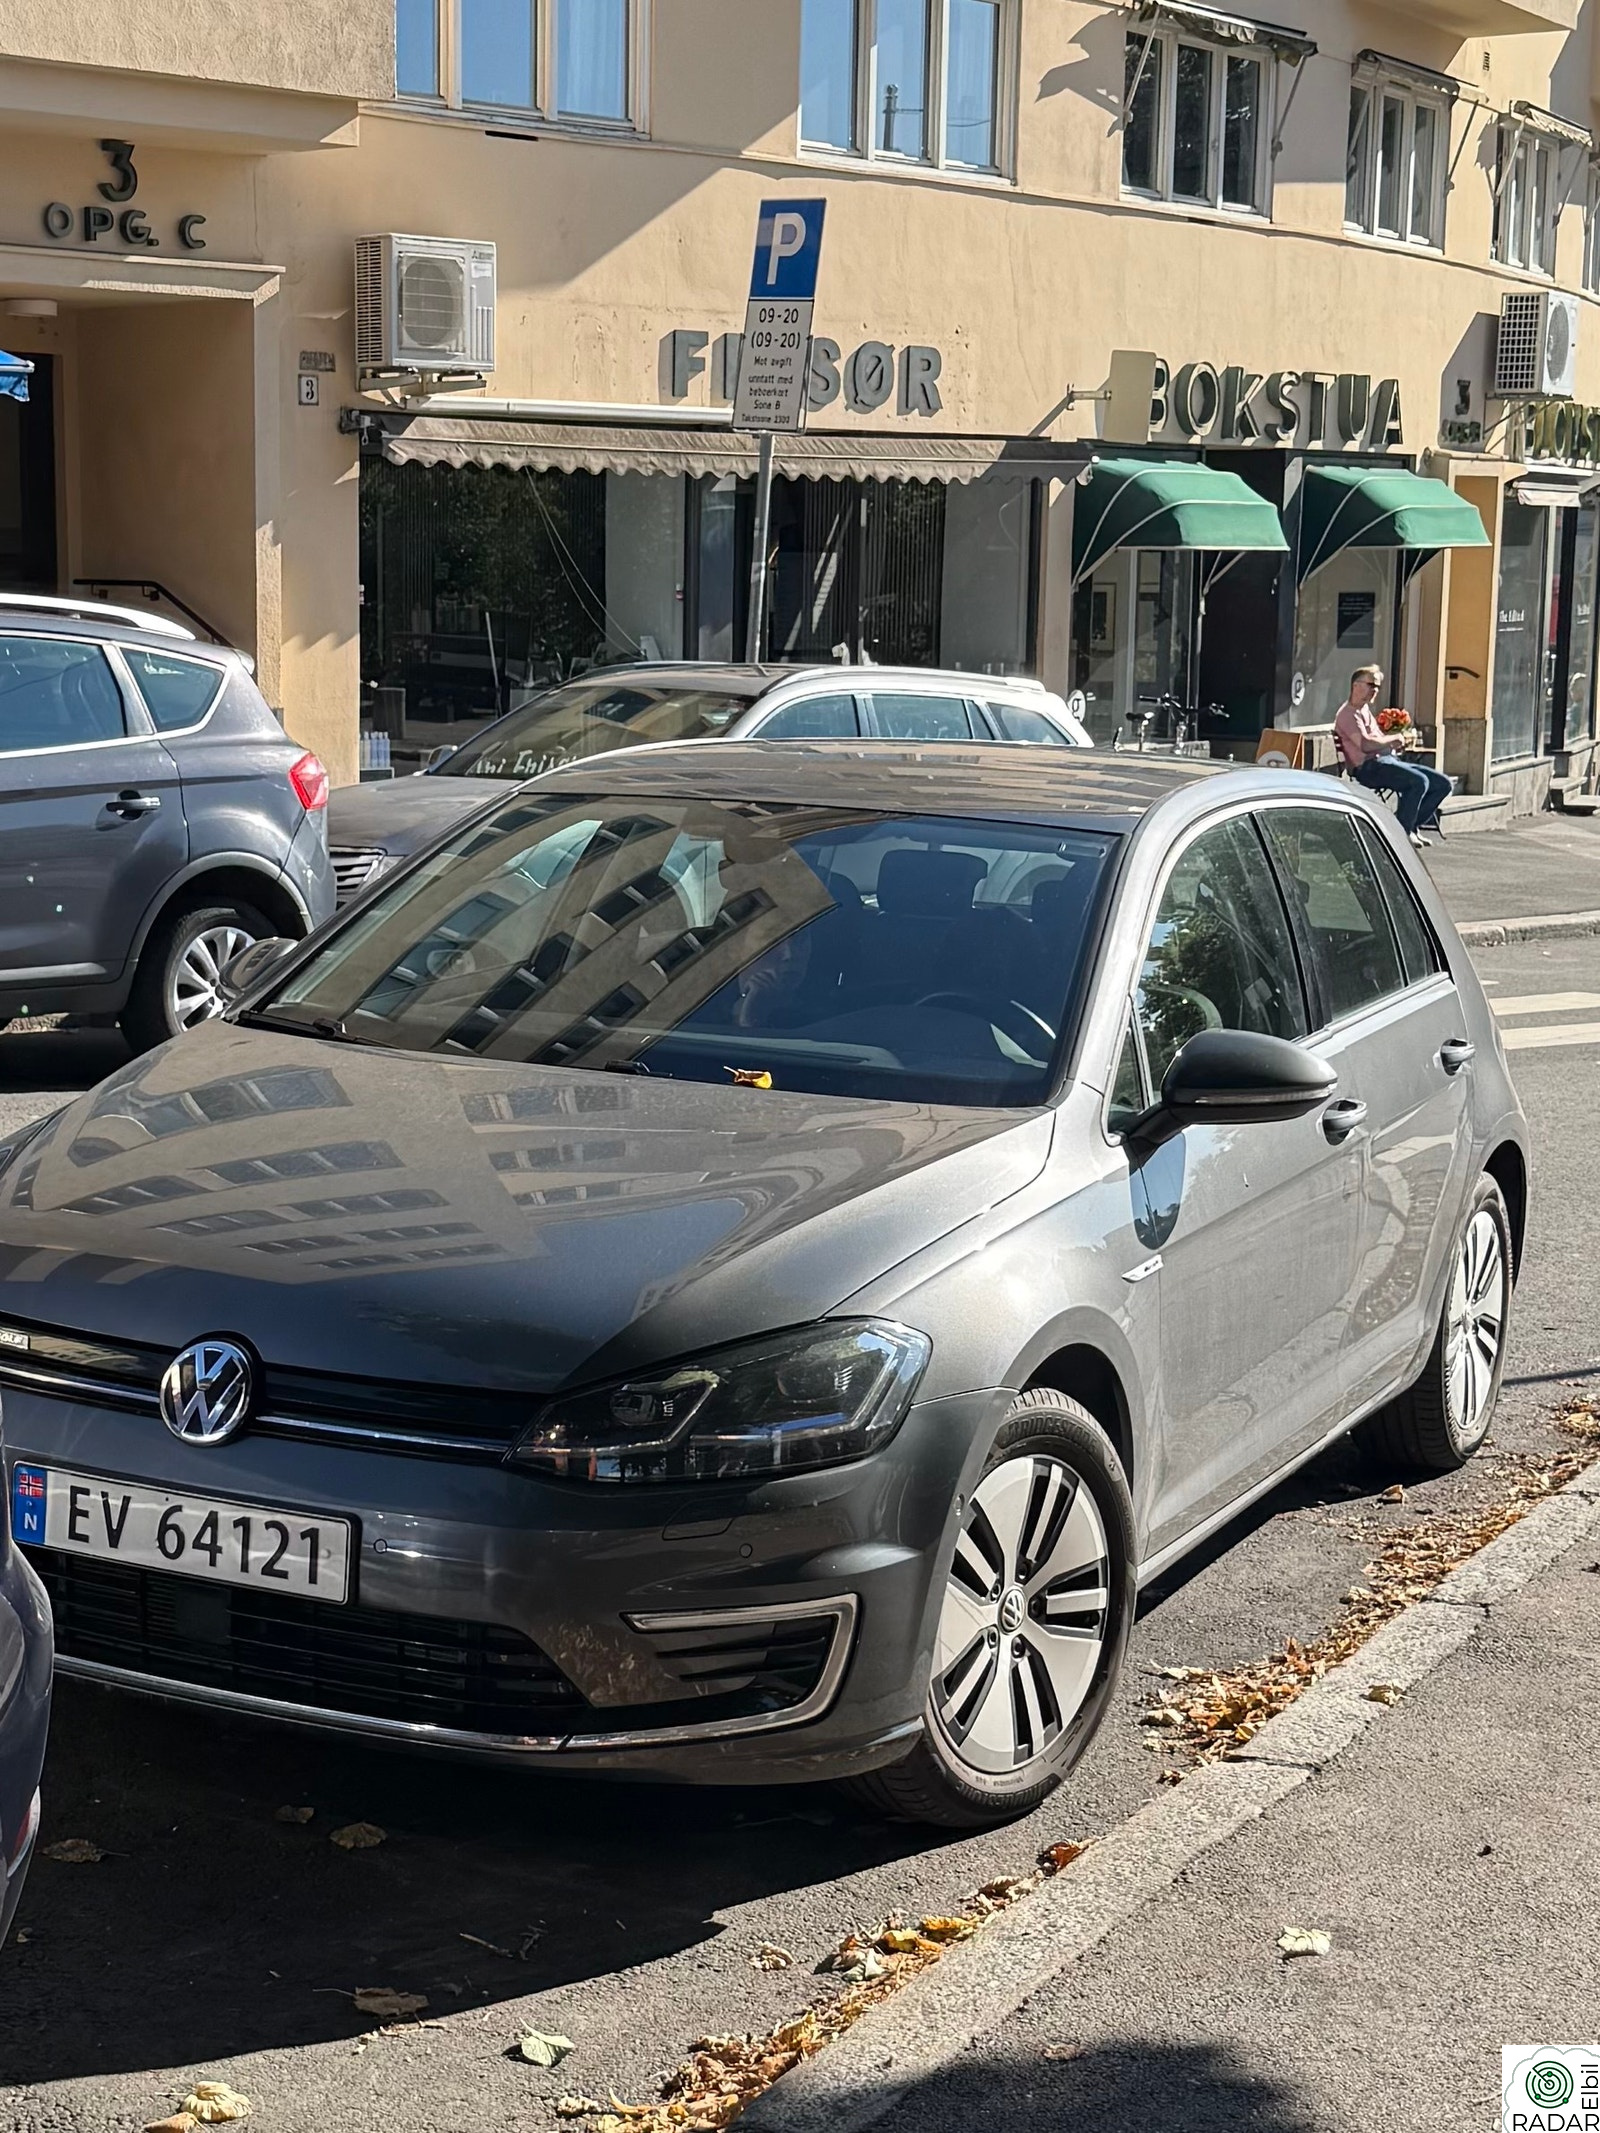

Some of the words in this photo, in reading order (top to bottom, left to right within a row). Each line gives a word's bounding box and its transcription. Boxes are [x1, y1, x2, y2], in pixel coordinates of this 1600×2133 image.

[97, 138, 139, 202] 3
[43, 201, 160, 247] OPG.
[179, 214, 207, 249] C
[766, 212, 807, 285] P
[306, 379, 315, 401] 3
[753, 399, 772, 410] Sone
[1149, 356, 1404, 446] BOKSTUA
[24, 1512, 37, 1531] N
[67, 1484, 131, 1549] EV
[156, 1505, 320, 1585] 64121
